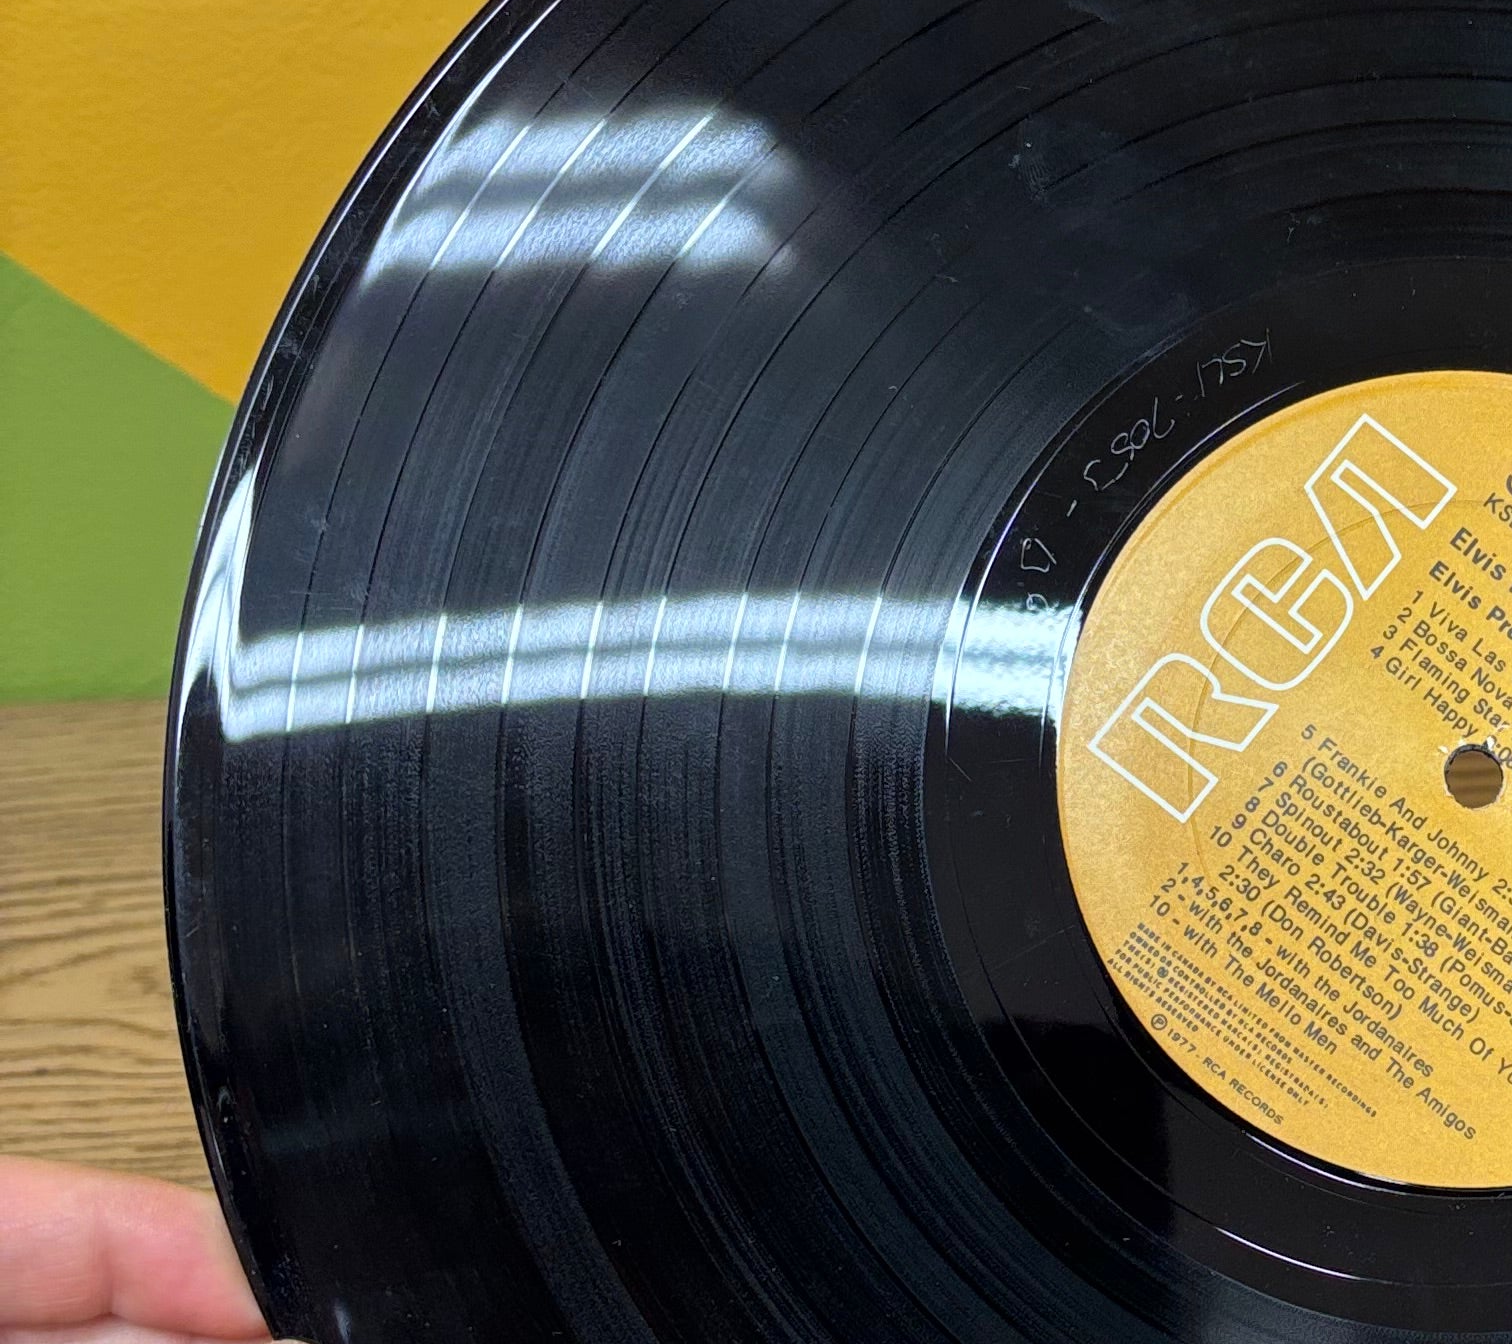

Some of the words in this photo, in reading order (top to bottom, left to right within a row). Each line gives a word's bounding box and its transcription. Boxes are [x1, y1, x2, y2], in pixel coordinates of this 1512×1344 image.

[1088, 413, 1458, 824] RCA
[1428, 560, 1482, 610] Elvis
[1449, 526, 1507, 581] Elvis
[1370, 645, 1385, 660] 4
[1385, 656, 1422, 691] Girl
[1422, 686, 1479, 738] Happy
[1382, 624, 1398, 640] 3
[1398, 637, 1471, 704] Flaming
[1473, 697, 1510, 733] Star
[1396, 607, 1413, 624] 2
[1412, 619, 1468, 672] Bossa
[1412, 590, 1424, 604] 1
[1429, 601, 1468, 643] Viva
[1471, 637, 1506, 673] Las
[1257, 776, 1274, 792] 7
[1275, 791, 1343, 853] Spinout
[1344, 847, 1386, 886] 2:32
[1272, 761, 1288, 778] 6
[1288, 774, 1389, 862] Roustabout
[1392, 857, 1433, 892] 1:57
[1301, 724, 1317, 740] 5
[1317, 737, 1387, 799] Frankie
[1388, 797, 1429, 831] And
[1427, 828, 1490, 883] Johnny
[1209, 825, 1233, 848] 10
[1237, 844, 1281, 890] They
[1283, 884, 1352, 946] Remind
[1349, 940, 1377, 969] Me
[1383, 964, 1416, 1000] Too
[1418, 995, 1464, 1041] Much
[1469, 1037, 1495, 1062] Of
[1218, 864, 1261, 902] 2:30
[1260, 899, 1304, 942] (Don
[1307, 935, 1403, 1021] Robertson)
[1231, 813, 1248, 830] 9
[1249, 828, 1301, 876] Charo
[1304, 873, 1346, 911] 2:43
[1343, 907, 1480, 1023] (Davis-Strange)
[1245, 796, 1261, 813] 8
[1261, 809, 1325, 866] Double
[1330, 861, 1396, 925] Trouble
[1401, 922, 1439, 958] 1:38
[1149, 894, 1171, 917] 10
[1183, 924, 1218, 959] with
[1224, 952, 1255, 987] The
[1255, 981, 1302, 1026] Mello
[1303, 1020, 1337, 1055] Men
[1160, 877, 1177, 893] 2
[1189, 900, 1223, 935] with
[1226, 931, 1253, 959] the
[1255, 958, 1348, 1036] Jordanaires
[1350, 1034, 1383, 1061] and
[1385, 1056, 1415, 1089] The
[1415, 1087, 1476, 1140] Amigos
[1177, 862, 1263, 937] 1,4,5,6,7,8
[1276, 944, 1311, 980] with
[1313, 975, 1340, 1002] the
[1342, 1001, 1434, 1078] Jordanaires
[1167, 1028, 1197, 1053] 1977
[1202, 1056, 1226, 1080] RCA
[1228, 1078, 1284, 1125] RECORDS
